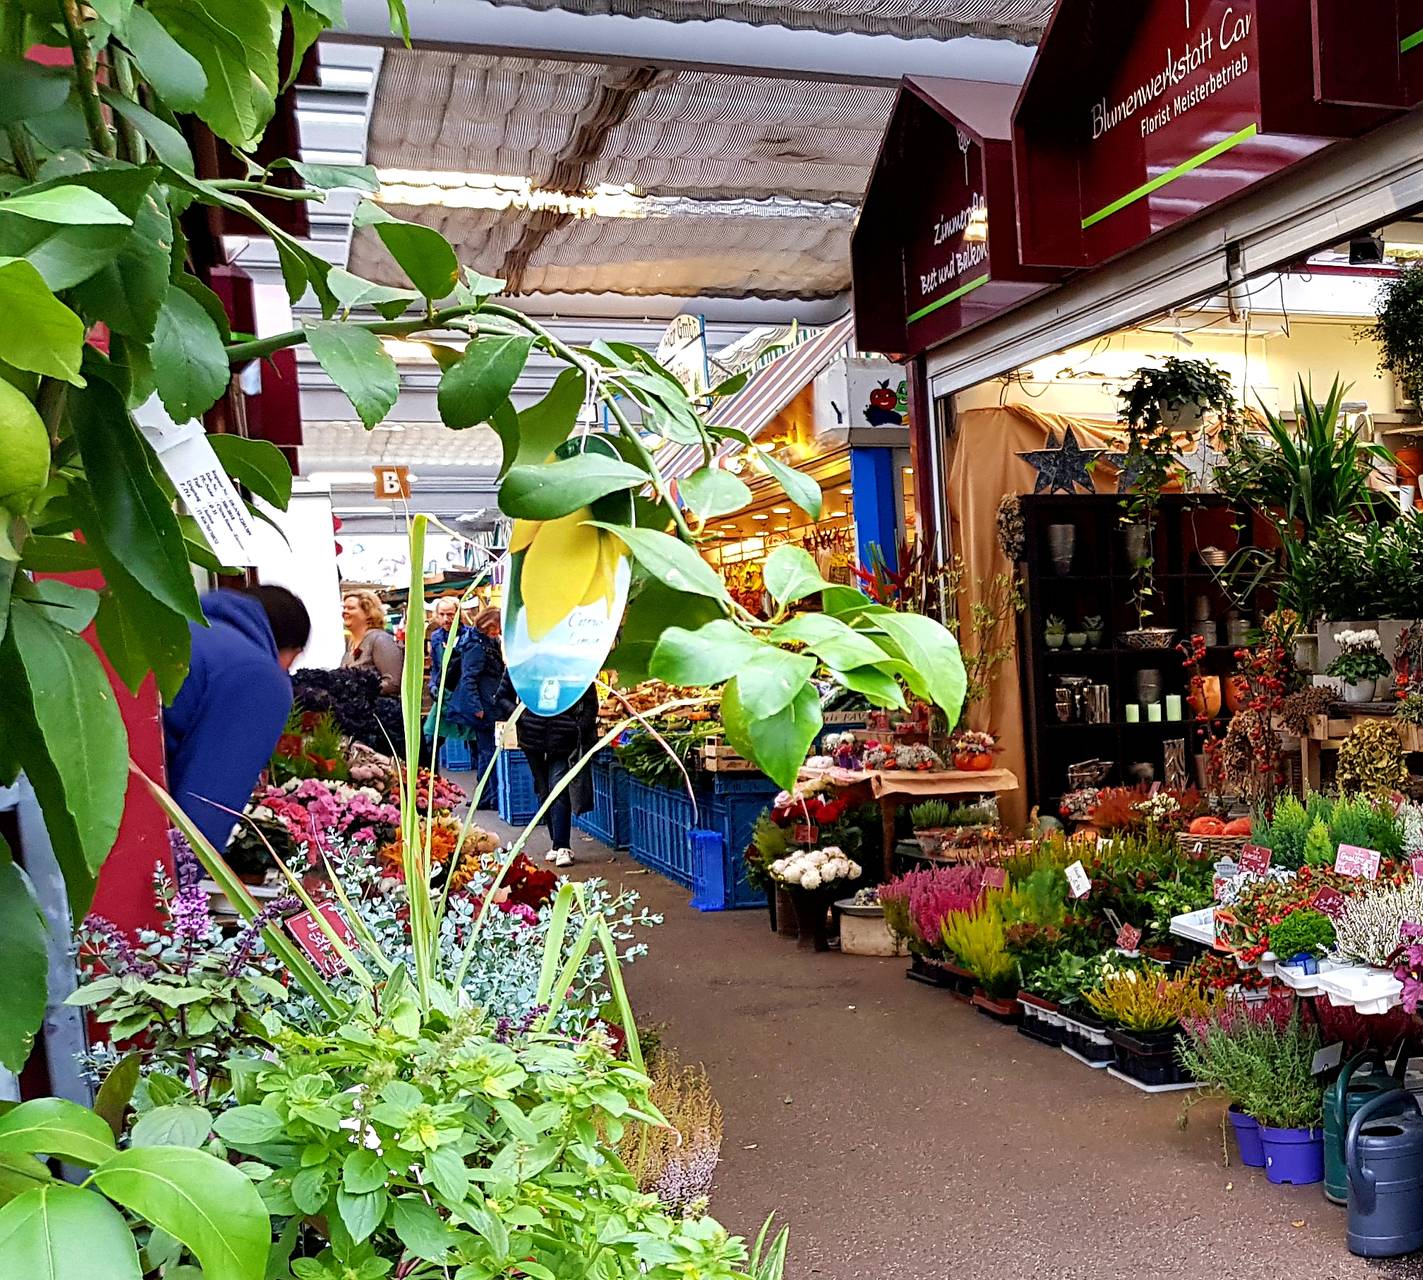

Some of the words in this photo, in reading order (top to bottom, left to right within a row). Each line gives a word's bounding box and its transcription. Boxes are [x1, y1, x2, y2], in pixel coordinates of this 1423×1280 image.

[1091, 27, 1213, 140] Blumenwerkstatt
[1141, 105, 1171, 138] Florist
[1174, 53, 1248, 117] Meisterbetrieb
[920, 267, 938, 295] Beet
[938, 252, 956, 285] und
[382, 471, 400, 494] B
